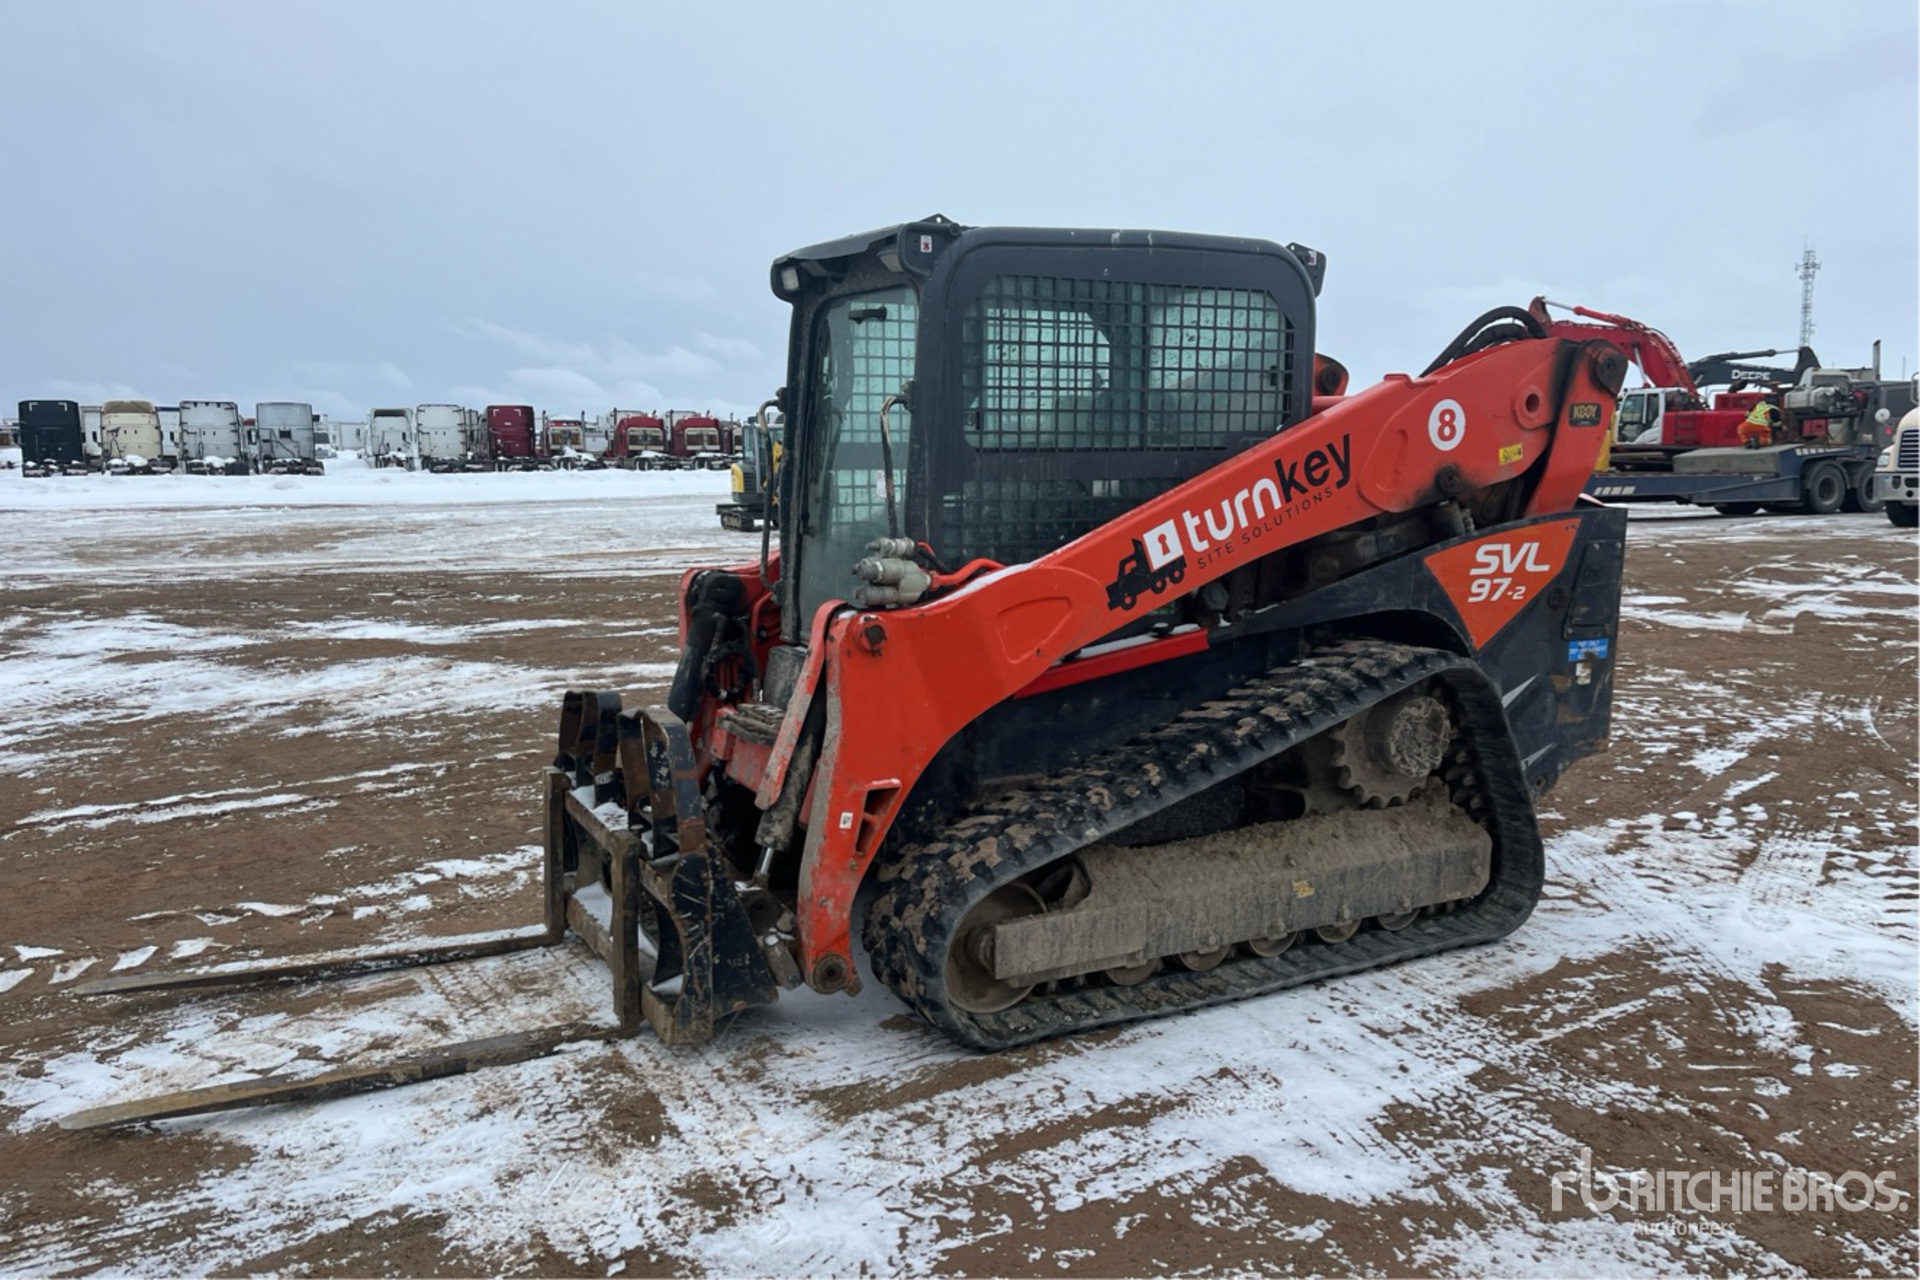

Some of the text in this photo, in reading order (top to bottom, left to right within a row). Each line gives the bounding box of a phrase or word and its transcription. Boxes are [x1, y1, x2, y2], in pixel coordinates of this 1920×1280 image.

[1437, 408, 1457, 442] 8
[1182, 433, 1350, 552] turnkey
[1197, 486, 1333, 569] SITE SOLUTIONS
[1469, 542, 1551, 575] SVL
